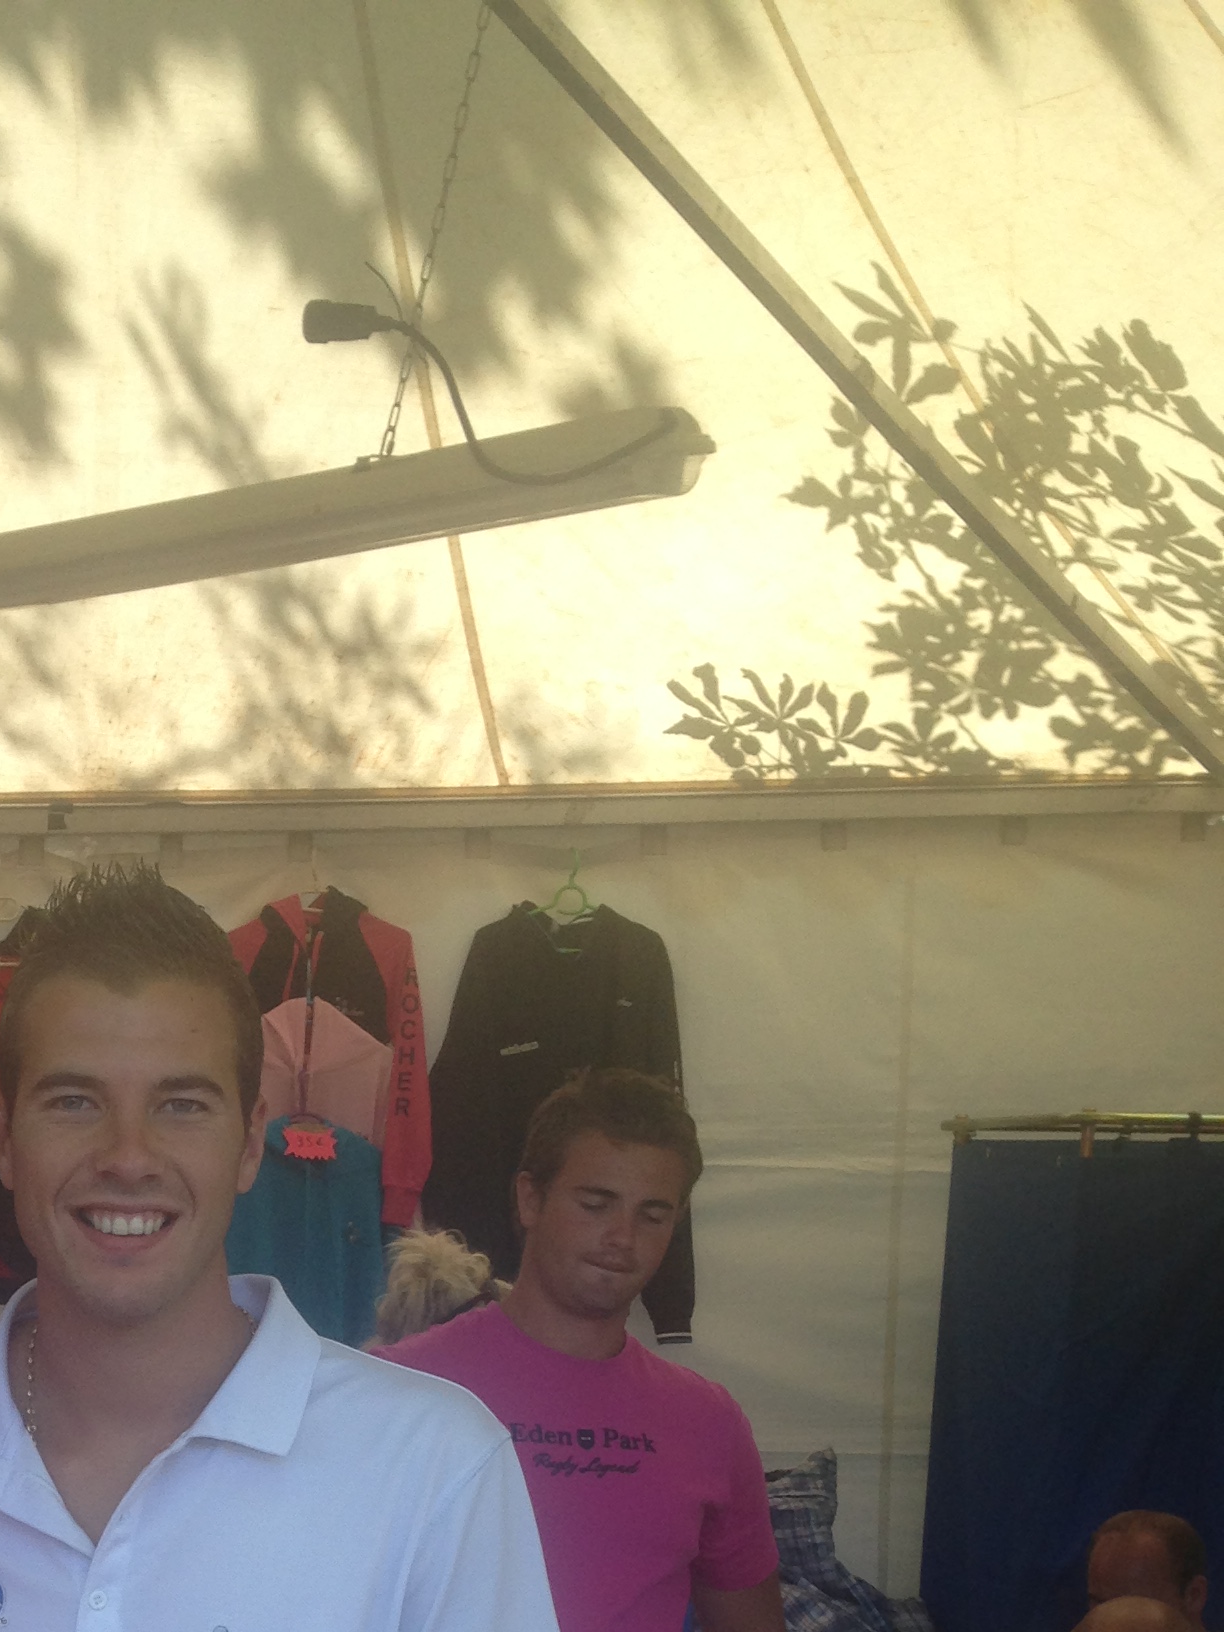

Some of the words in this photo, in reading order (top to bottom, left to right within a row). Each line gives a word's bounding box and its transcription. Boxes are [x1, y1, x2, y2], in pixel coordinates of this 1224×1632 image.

[394, 967, 420, 1118] ROCHER
[510, 1423, 573, 1447] Eden
[602, 1428, 657, 1454] Park
